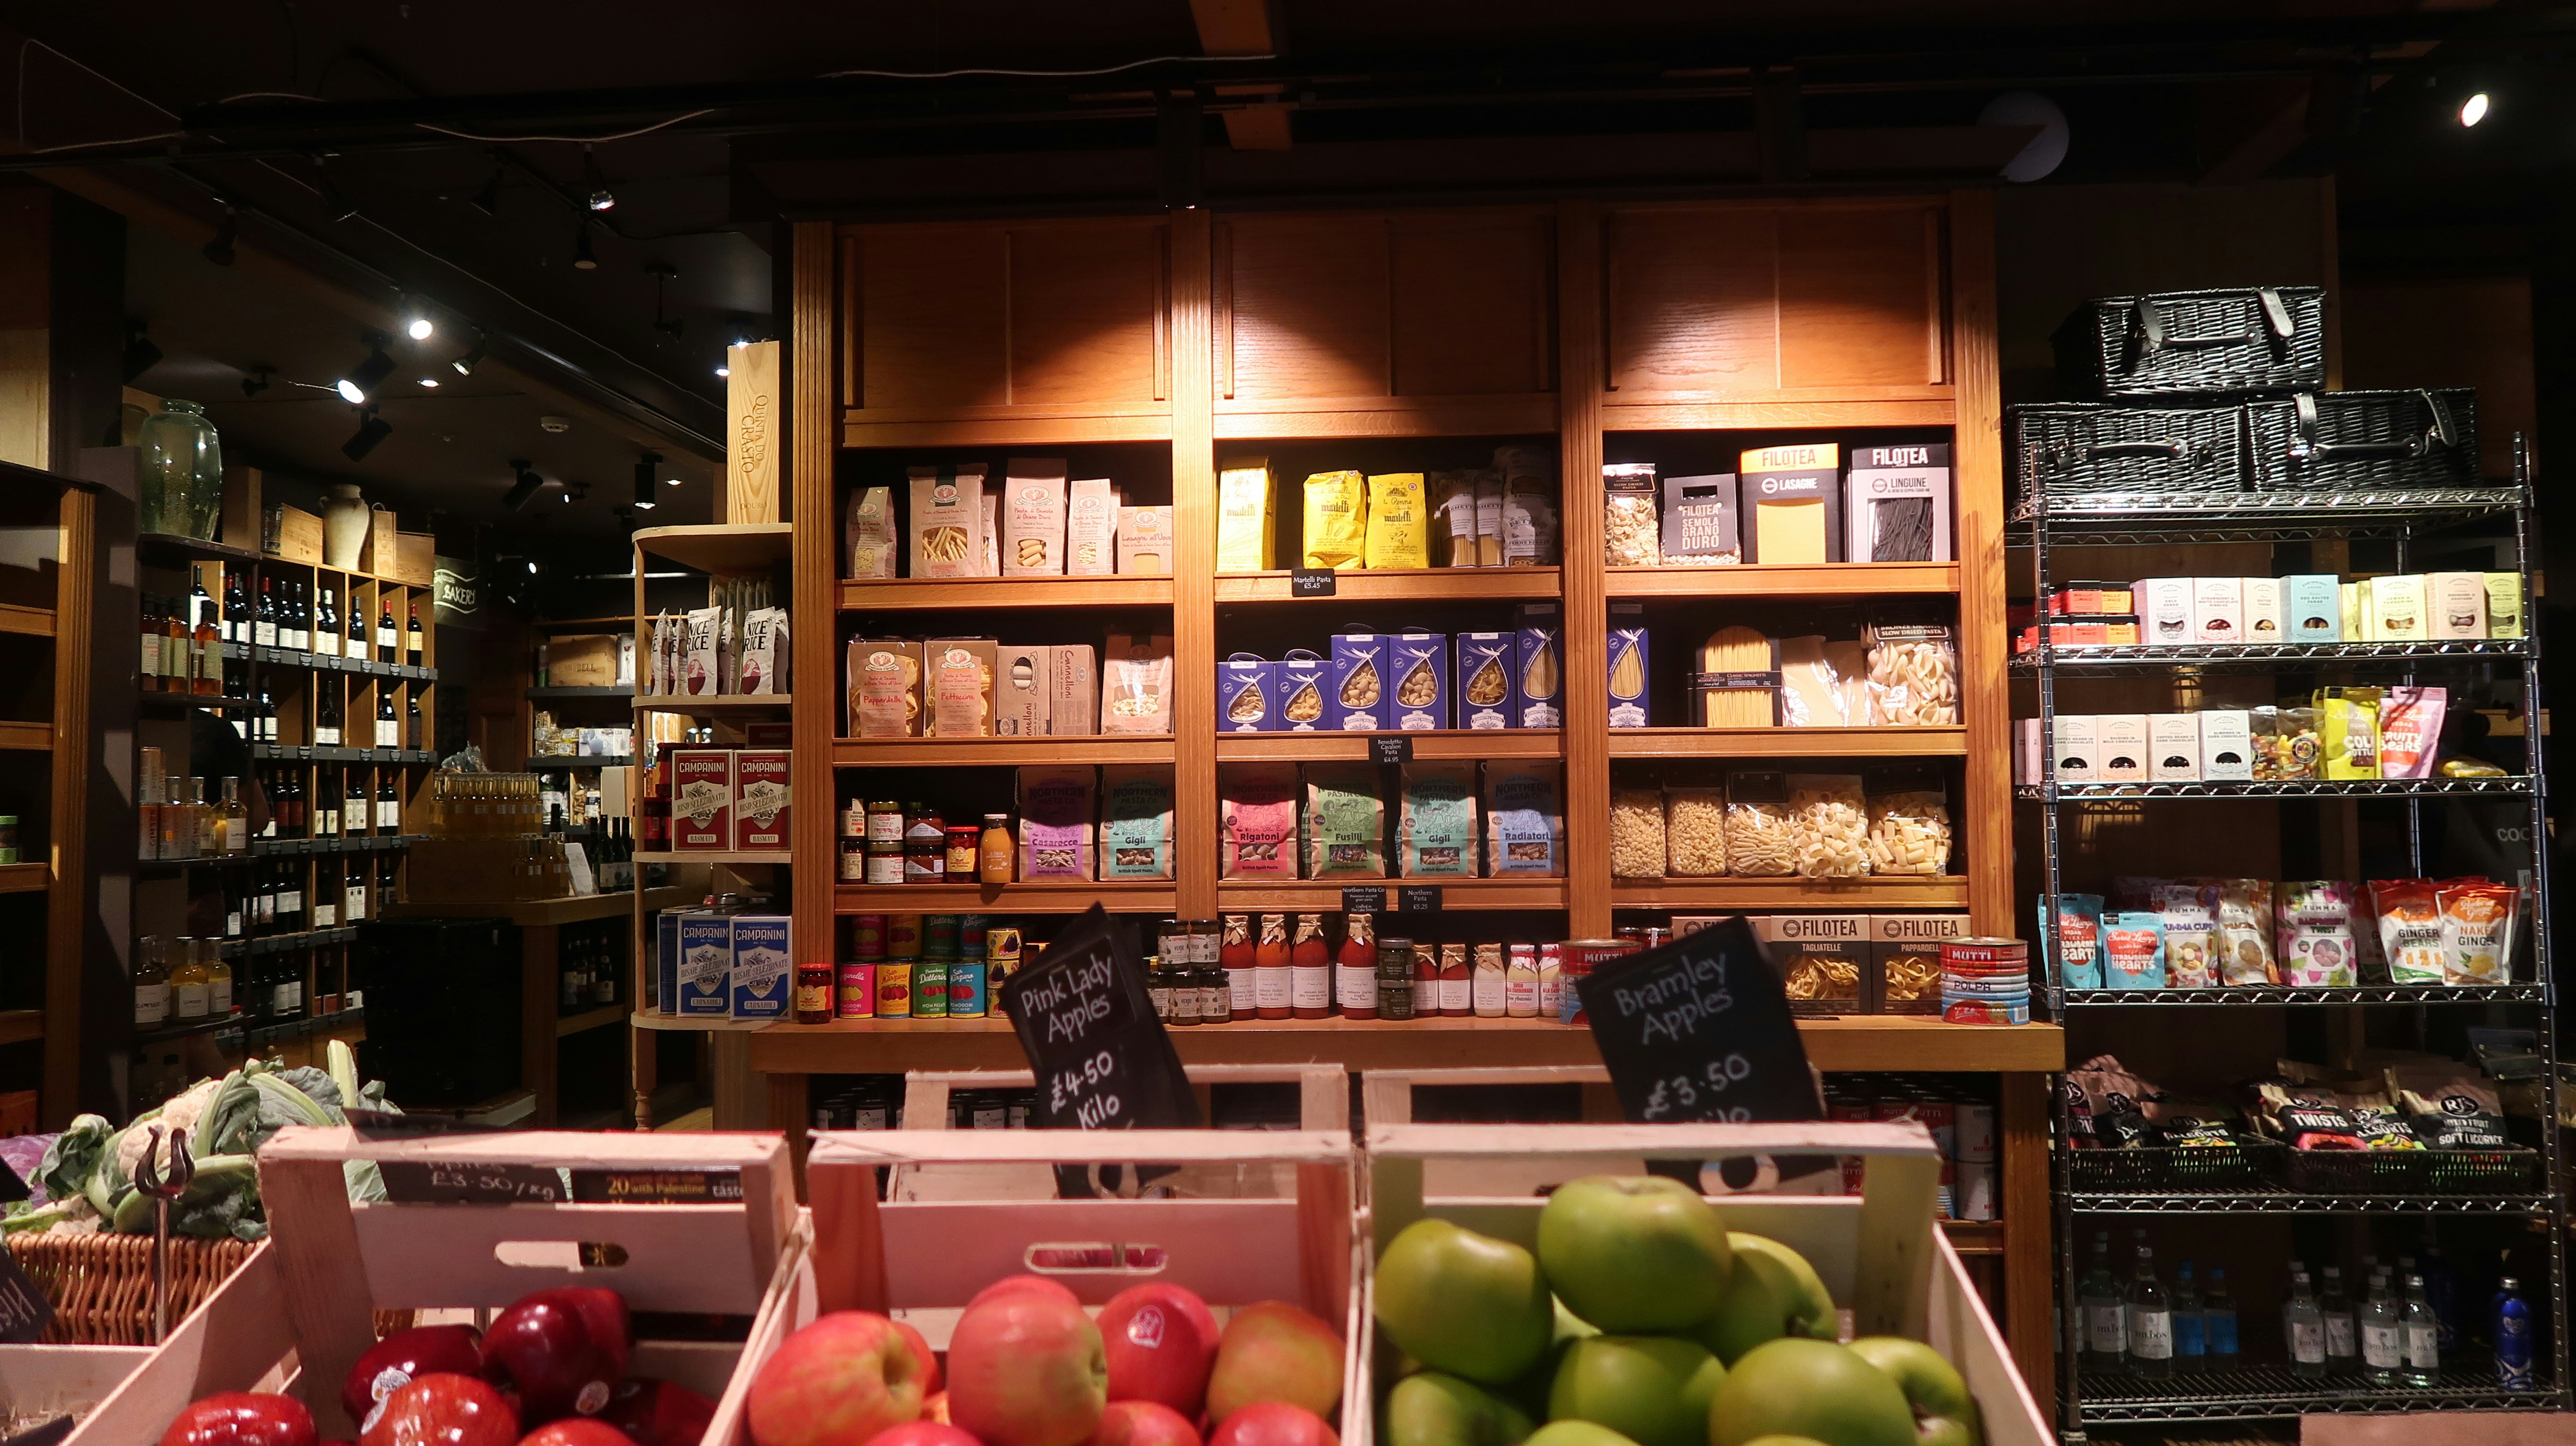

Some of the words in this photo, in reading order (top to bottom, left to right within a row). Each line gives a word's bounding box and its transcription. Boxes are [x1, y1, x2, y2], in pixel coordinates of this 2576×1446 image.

[753, 395, 768, 443] QUINTA
[741, 416, 754, 473] CRASTO
[755, 446, 765, 461] DO
[1762, 449, 1816, 466] FILOTEA
[1872, 447, 1929, 466] FILOTEA
[1779, 477, 1818, 491] LASAGNE
[1891, 477, 1927, 488] LINGUINE
[741, 502, 767, 510] DOURO
[1682, 505, 1719, 516] FILOTEA
[1682, 517, 1719, 527] SEMOLA
[1682, 526, 1719, 537] GRANO
[1122, 534, 1148, 543] Lasagne
[1682, 535, 1719, 550] DURO
[443, 584, 476, 605] BAKERY
[689, 620, 709, 635] NICE
[746, 620, 768, 634] NICE
[688, 636, 708, 651] RICE
[744, 636, 766, 651] RICE
[1065, 650, 1074, 699] Cannelloni
[863, 695, 902, 705] Pappardelle
[941, 692, 975, 701] Fettuccine
[2343, 735, 2374, 748] COL
[2382, 732, 2423, 742] FRUITY
[679, 763, 724, 772] CAMPANINI
[741, 763, 786, 772] CAMPANINI
[1030, 787, 1085, 800] NORTHERN
[1113, 787, 1167, 798] NORTHERN
[1411, 784, 1467, 795] NORTHERN
[1496, 782, 1552, 795] NORTHERN
[691, 792, 725, 809] SELEZIONATO
[753, 792, 787, 809] SELEZIONATO
[1125, 836, 1146, 846] Gigli
[1240, 832, 1280, 843] Rigatoni
[1336, 833, 1362, 842] Fusilli
[1429, 835, 1450, 844] Gigli
[1505, 832, 1548, 840] Radiatori
[2497, 827, 2529, 842] COC
[684, 927, 730, 938] CAMPANIN
[1803, 920, 1858, 936] FILOTEA
[1904, 920, 1959, 936] FILOTEA
[2399, 929, 2440, 938] GINGER
[736, 930, 785, 940] CAMPANINI
[1802, 943, 1842, 952] TAGLIATELLE
[1901, 944, 1941, 952] PAPPARDELL
[2400, 939, 2439, 947] BEARS
[1952, 950, 1991, 961] MUTTI
[1021, 975, 1067, 1018] Pink
[1066, 953, 1112, 995] Lady
[1614, 953, 1726, 1017] Bramley
[1954, 981, 1990, 991] POLPA
[1048, 993, 1111, 1044] Apples
[1642, 987, 1734, 1045] Apples
[1051, 1051, 1113, 1115] £4.50
[1643, 1053, 1752, 1120] £3.50
[1077, 1093, 1121, 1131] Kilo
[2290, 1114, 2349, 1127] TWISTS
[2356, 1122, 2414, 1138] LLSORTS
[2438, 1135, 2463, 1145] SOFT
[2465, 1133, 2504, 1145] LICORICE
[607, 1177, 628, 1196] 20
[631, 1184, 653, 1195] with
[656, 1182, 705, 1196] Palestine
